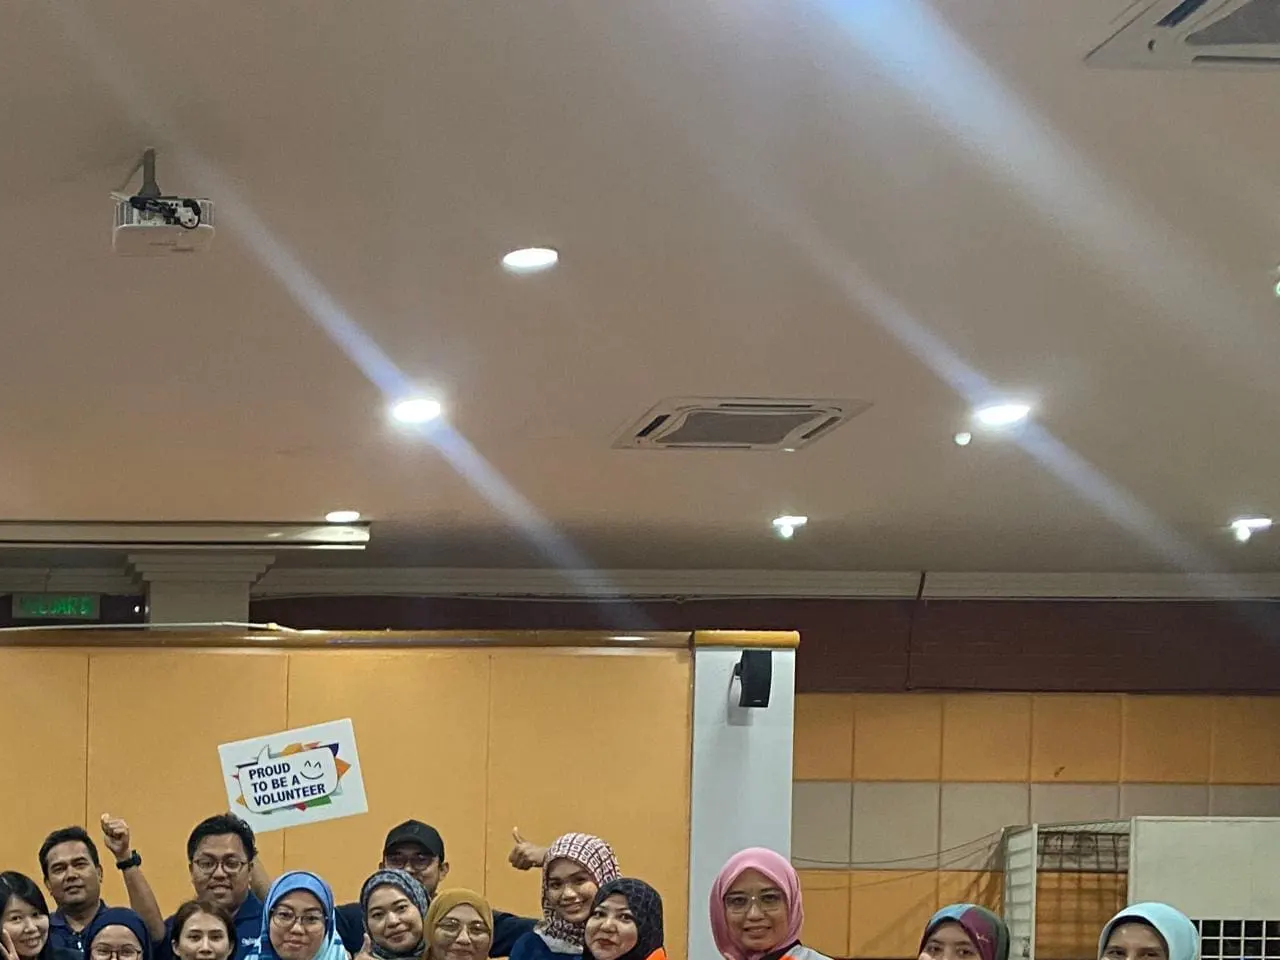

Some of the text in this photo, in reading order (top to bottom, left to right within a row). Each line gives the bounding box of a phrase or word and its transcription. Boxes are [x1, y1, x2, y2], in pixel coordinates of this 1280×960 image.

[249, 762, 291, 780] PROUD
[251, 774, 301, 793] TO BE A
[254, 783, 327, 806] VOLUNTEER
